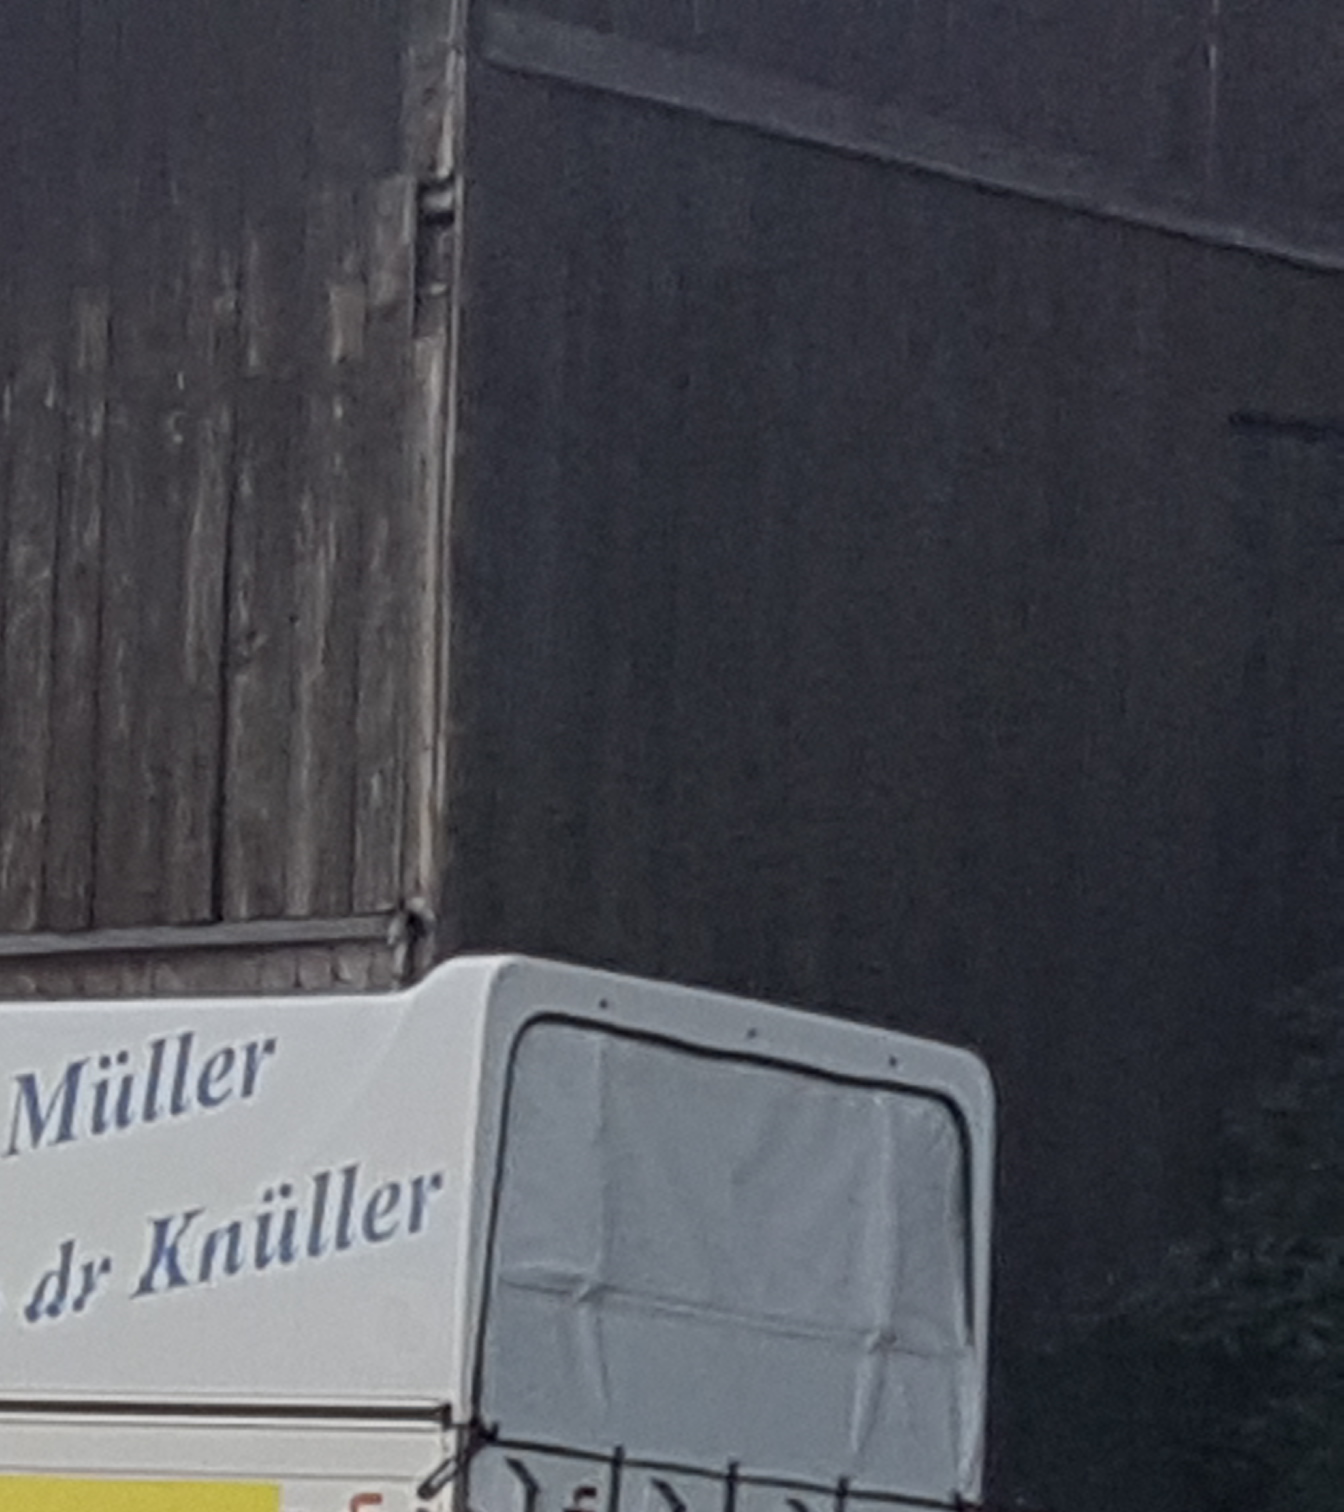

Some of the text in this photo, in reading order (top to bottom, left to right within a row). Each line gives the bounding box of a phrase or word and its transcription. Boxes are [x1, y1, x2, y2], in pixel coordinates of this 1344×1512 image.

[2, 1030, 277, 1160] Müller
[23, 1240, 113, 1325] dr
[130, 1162, 447, 1302] Knüller
